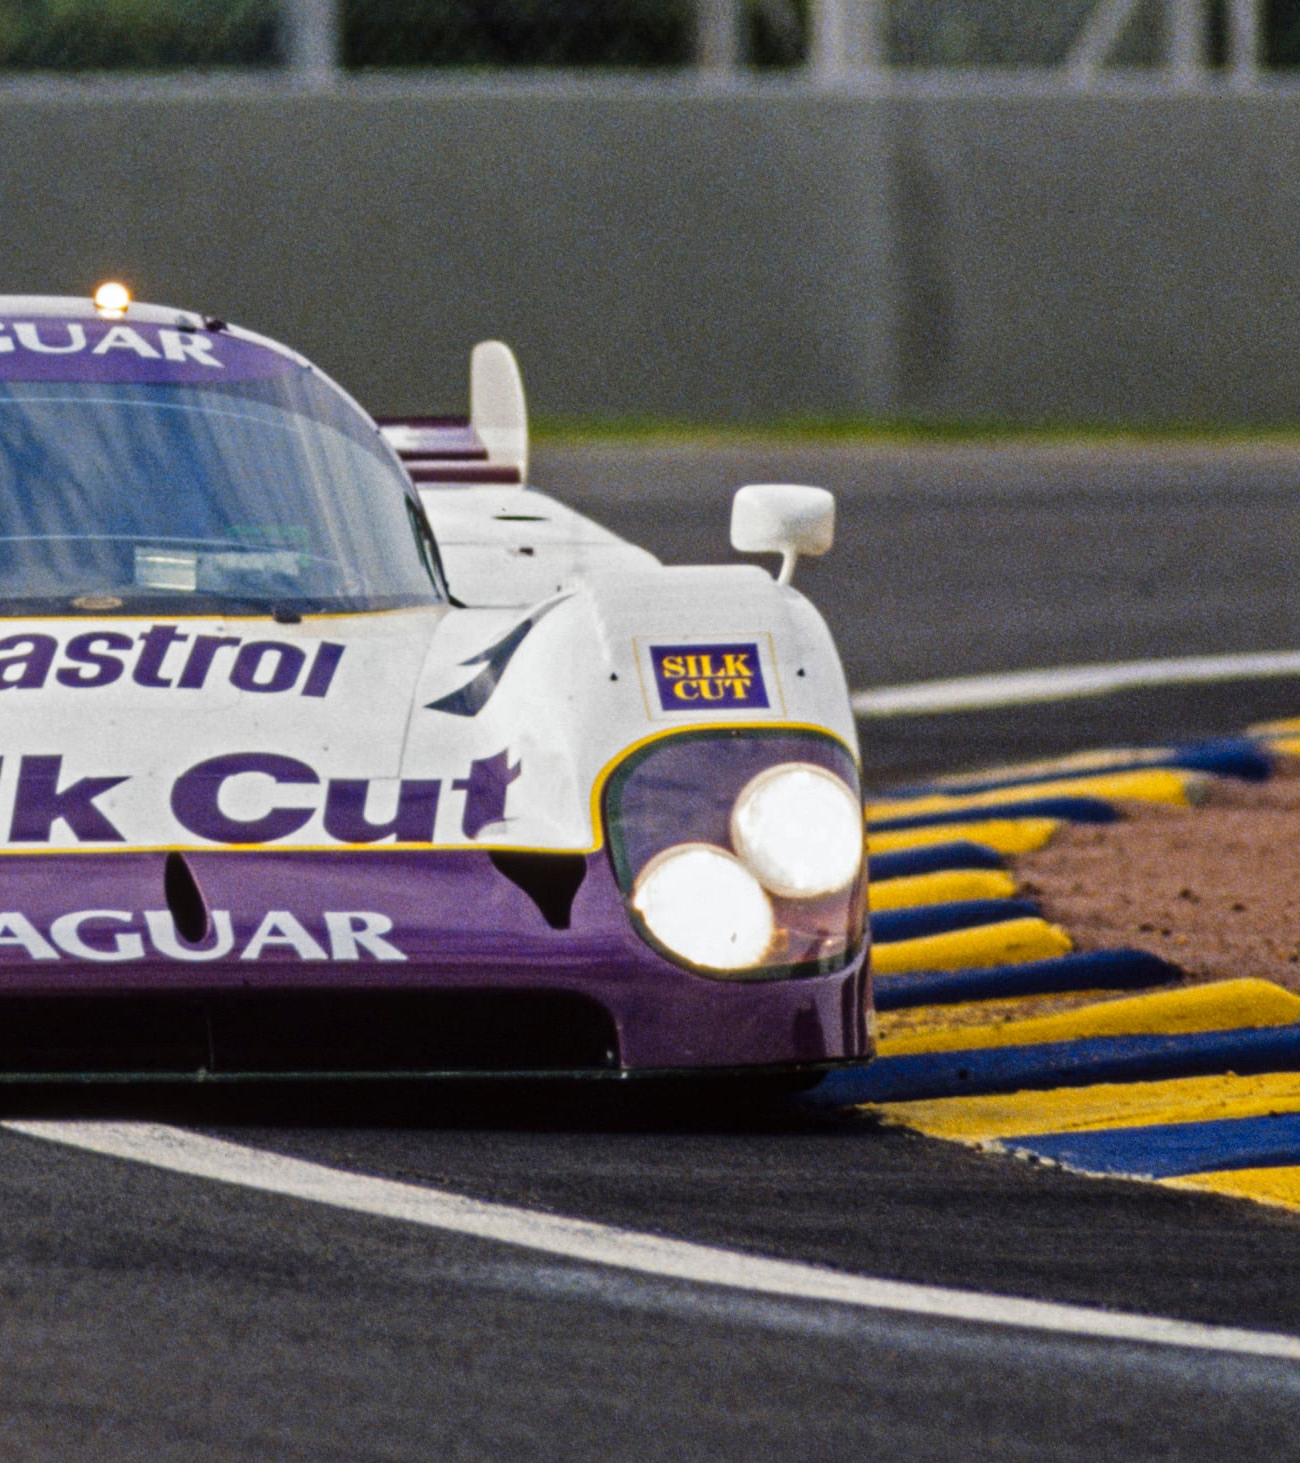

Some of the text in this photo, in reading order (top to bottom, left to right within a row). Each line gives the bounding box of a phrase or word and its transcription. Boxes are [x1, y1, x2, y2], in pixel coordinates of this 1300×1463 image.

[661, 653, 754, 679] SILK
[673, 677, 752, 701] CUT
[170, 746, 523, 844] Cut
